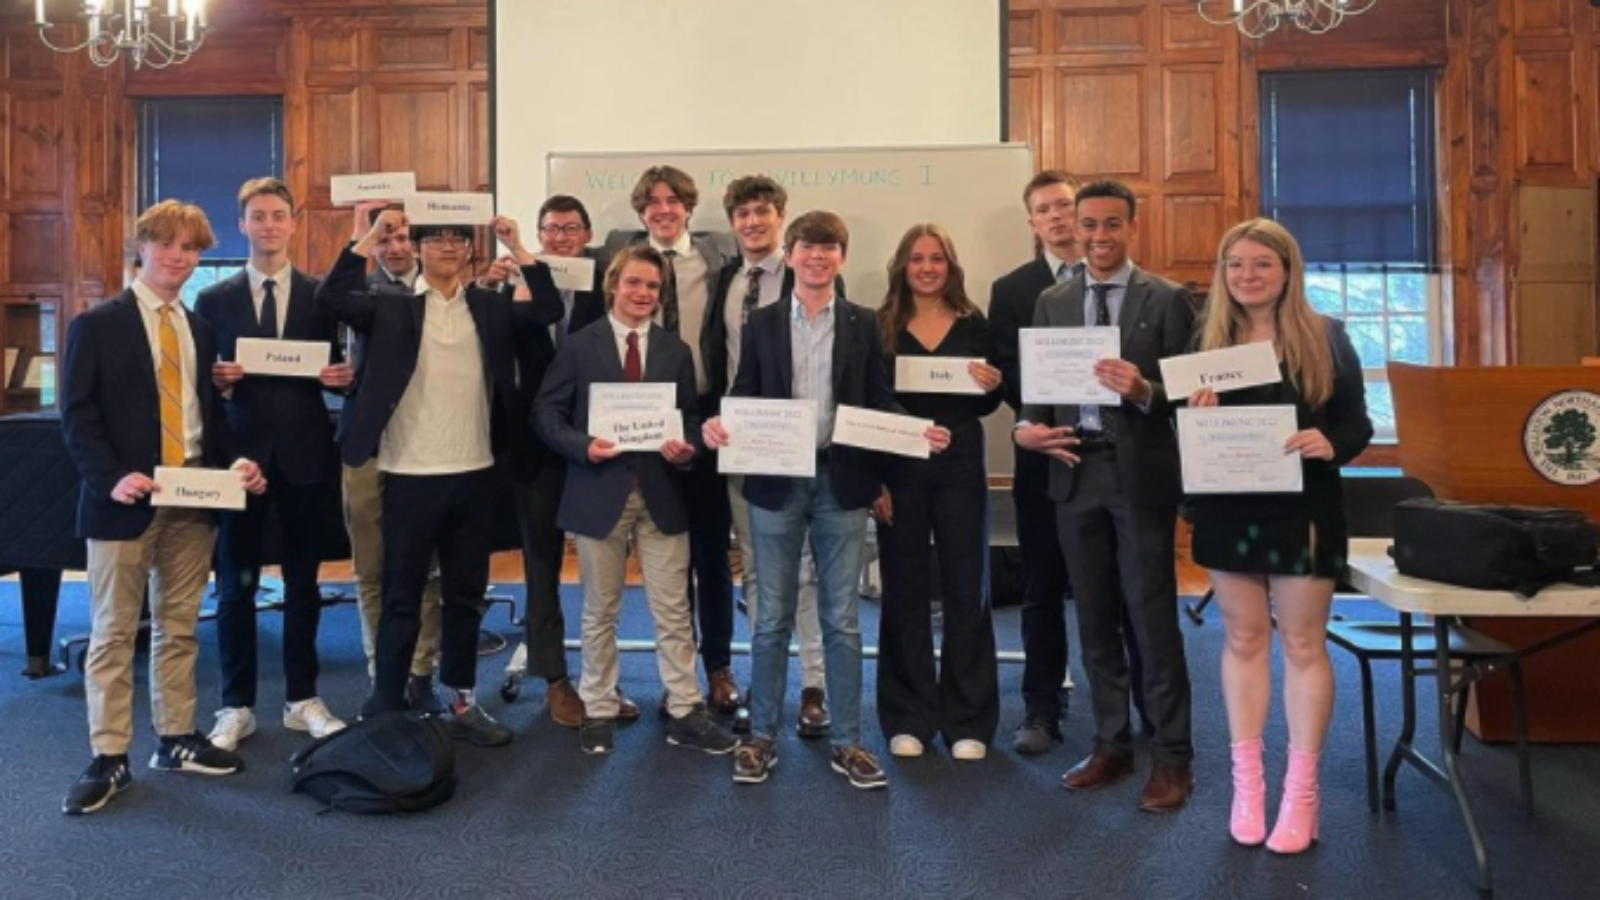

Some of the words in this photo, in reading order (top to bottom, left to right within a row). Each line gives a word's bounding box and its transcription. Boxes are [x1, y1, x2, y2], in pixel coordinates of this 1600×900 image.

[266, 352, 301, 363] Poland
[931, 369, 953, 383] Italy
[1200, 371, 1243, 385] France
[614, 422, 630, 433] The
[633, 418, 665, 431] United
[618, 432, 663, 445] Kingdom
[174, 486, 221, 501] Hungary
